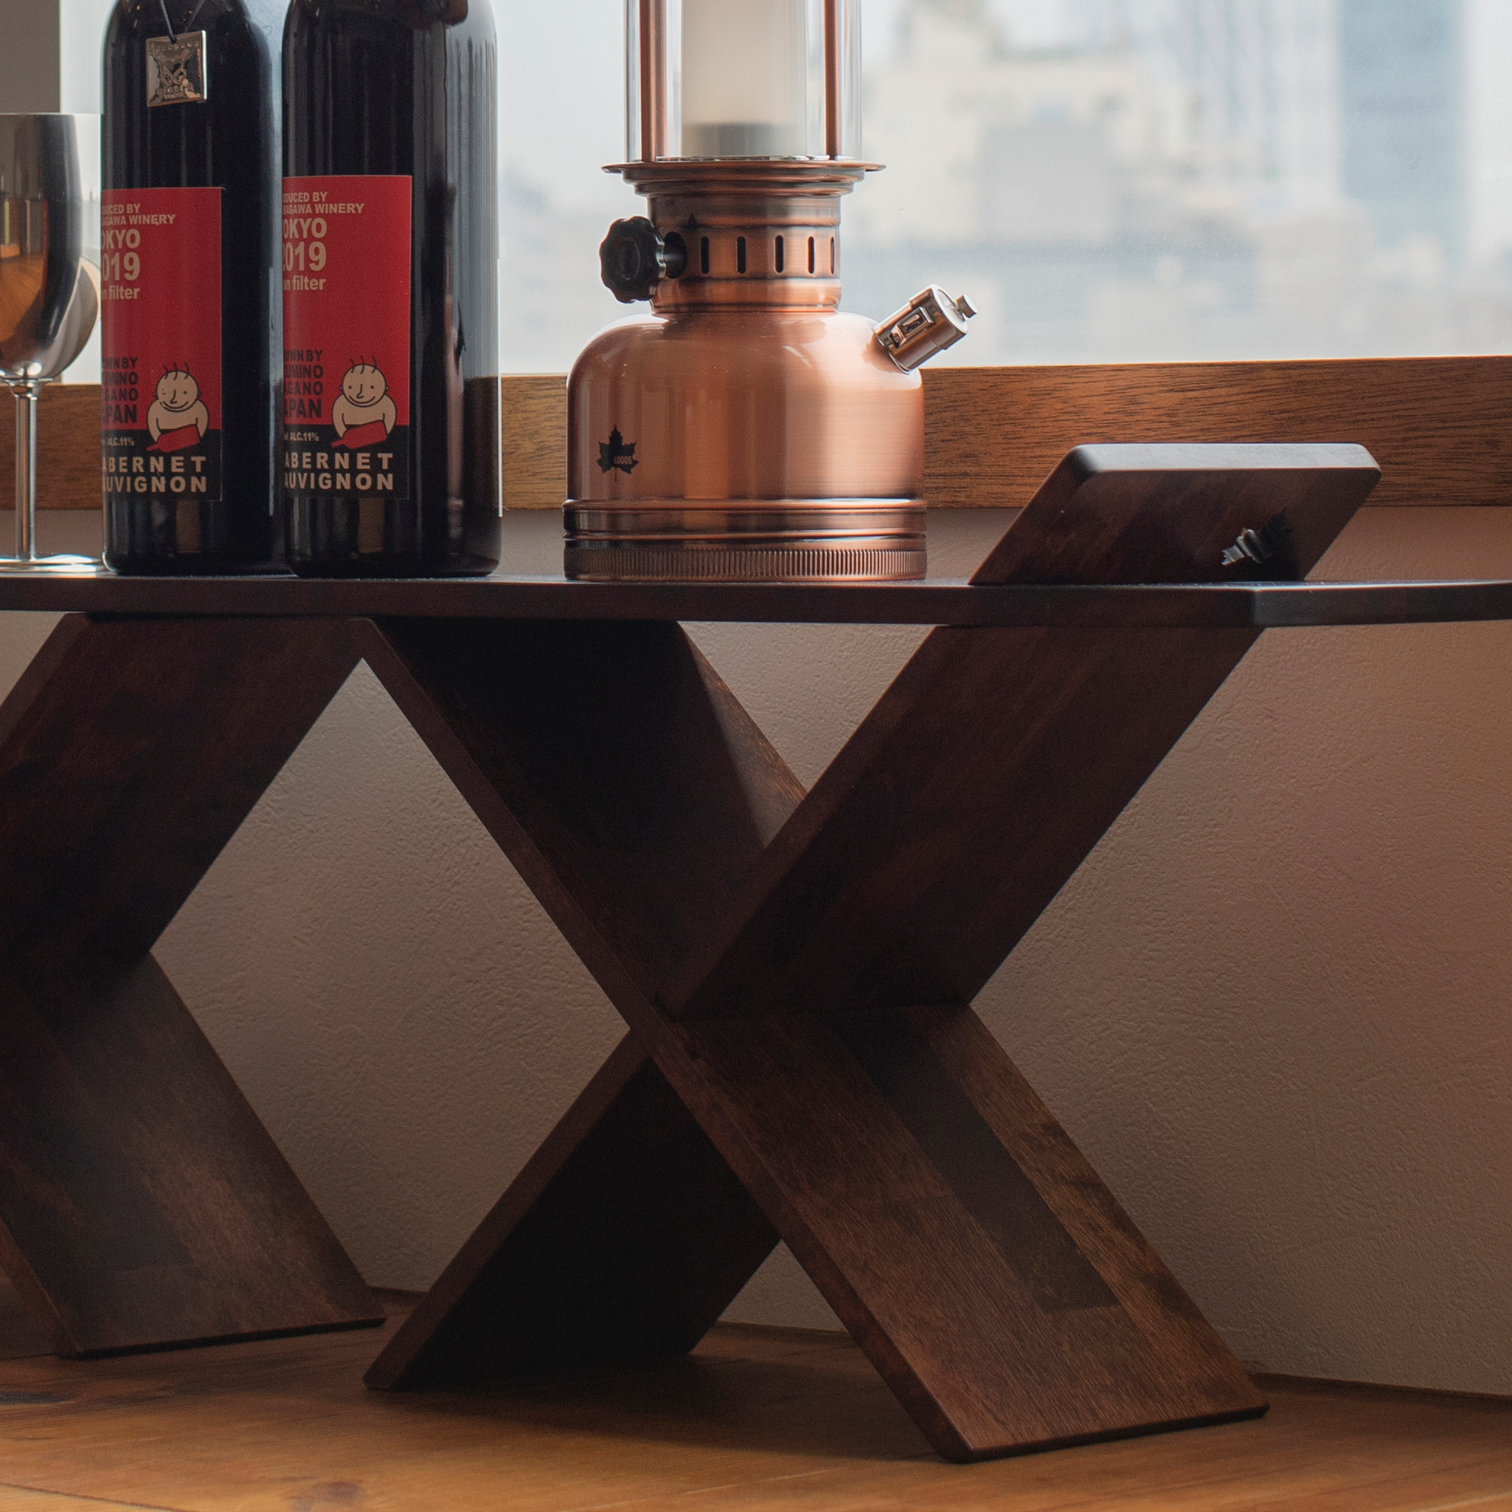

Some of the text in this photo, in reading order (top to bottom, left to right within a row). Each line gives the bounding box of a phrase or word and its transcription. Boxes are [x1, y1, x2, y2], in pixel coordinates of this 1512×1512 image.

[312, 191, 328, 202] BY
[126, 203, 141, 214] BY
[314, 203, 365, 214] WINERY
[128, 214, 176, 225] WINERY
[283, 217, 327, 239] OKYO
[101, 252, 141, 281] 019
[292, 275, 326, 291] filter
[109, 285, 141, 300] filter
[306, 349, 323, 362] BY
[121, 357, 138, 368] BY
[285, 452, 393, 469] ABERNET
